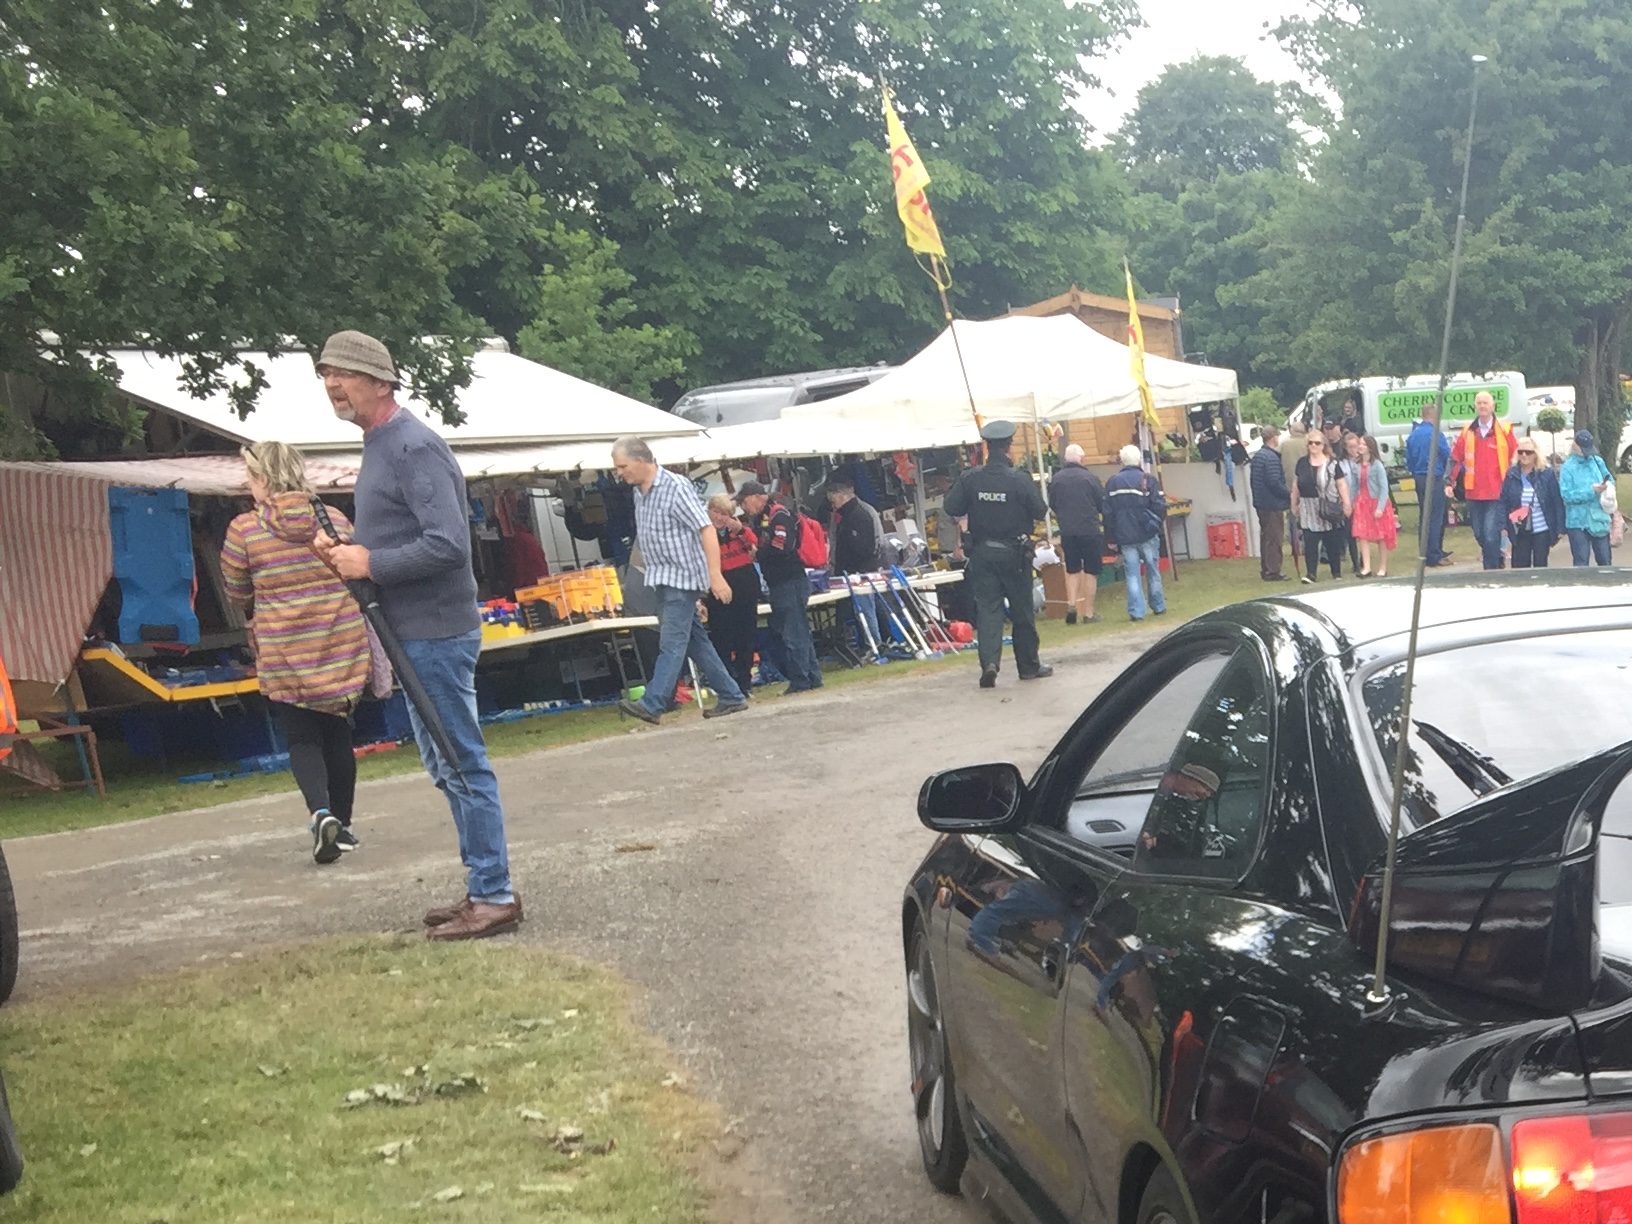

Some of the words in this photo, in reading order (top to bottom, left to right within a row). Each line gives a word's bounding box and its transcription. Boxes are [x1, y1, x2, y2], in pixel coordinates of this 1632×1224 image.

[1383, 394, 1438, 407] CHERRY
[1444, 390, 1504, 404] COTTGE
[1449, 403, 1502, 416] CENE
[978, 492, 1007, 502] POLICE
